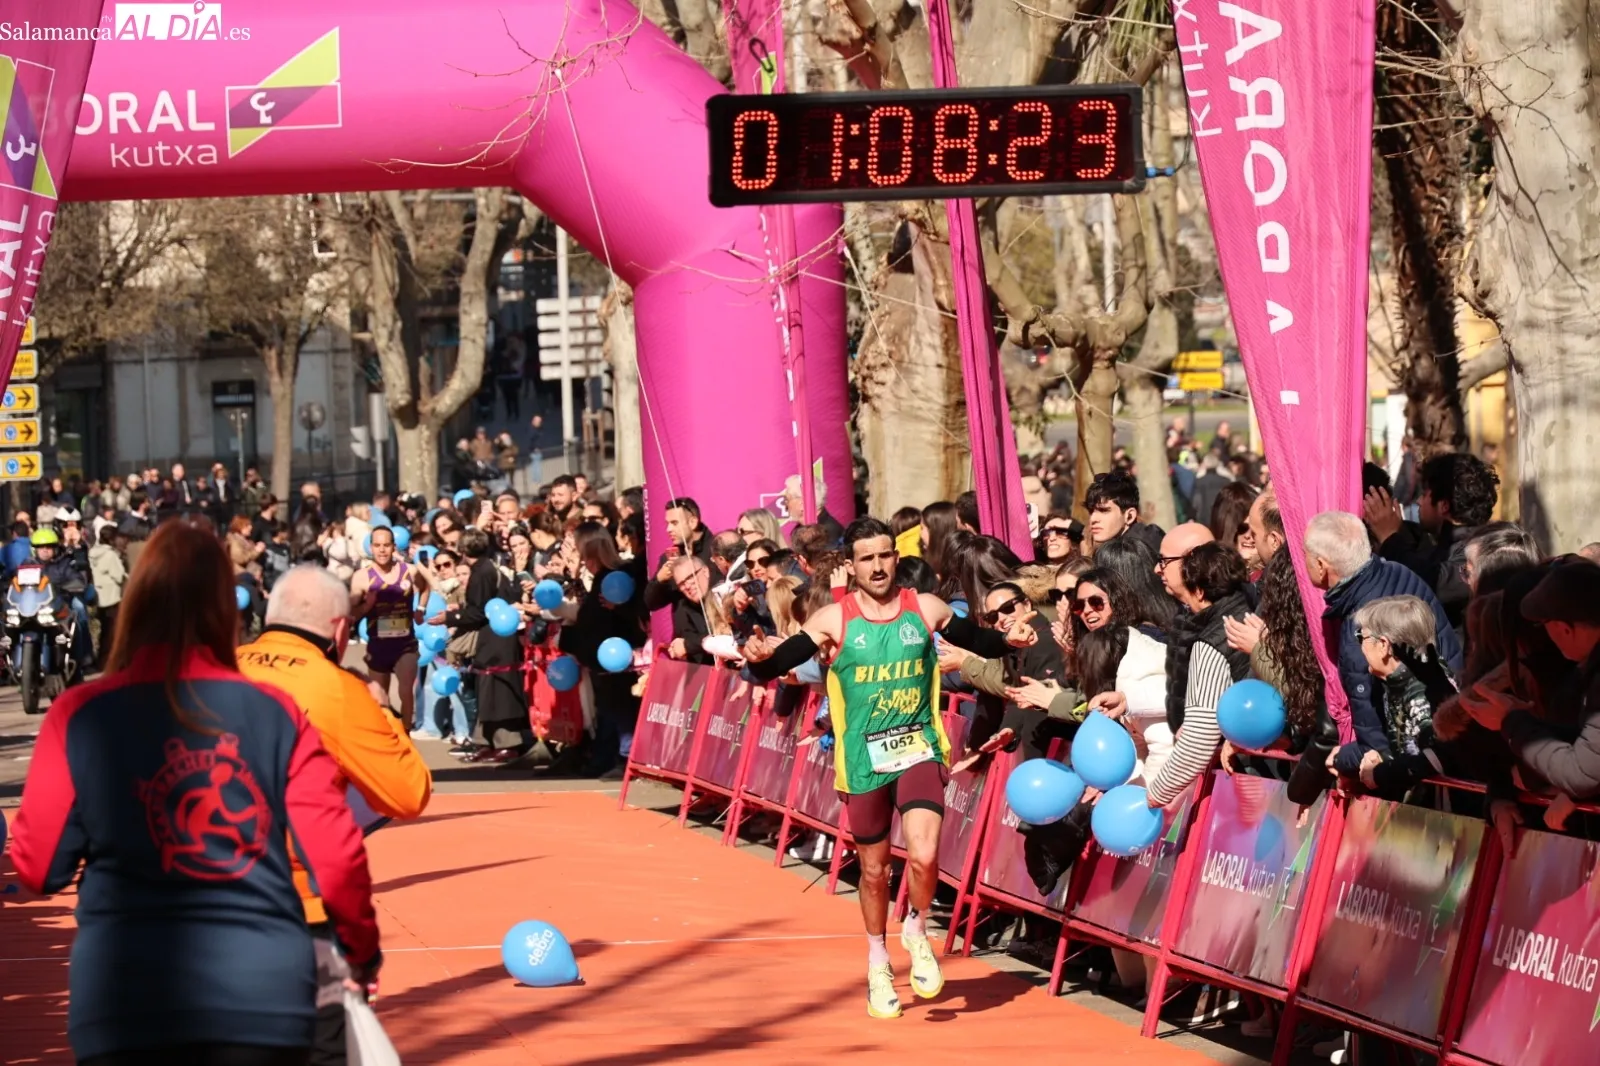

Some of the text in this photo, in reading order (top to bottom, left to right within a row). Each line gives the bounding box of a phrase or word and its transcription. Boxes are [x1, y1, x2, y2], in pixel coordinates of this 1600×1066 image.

[75, 89, 216, 138] ORAL
[110, 142, 218, 168] kutxa
[880, 735, 916, 752] 1052
[1201, 849, 1276, 899] LABORAL kutxa
[1335, 881, 1422, 941] LABORAL kutxa
[1492, 924, 1599, 993] LABORAL kutxa
